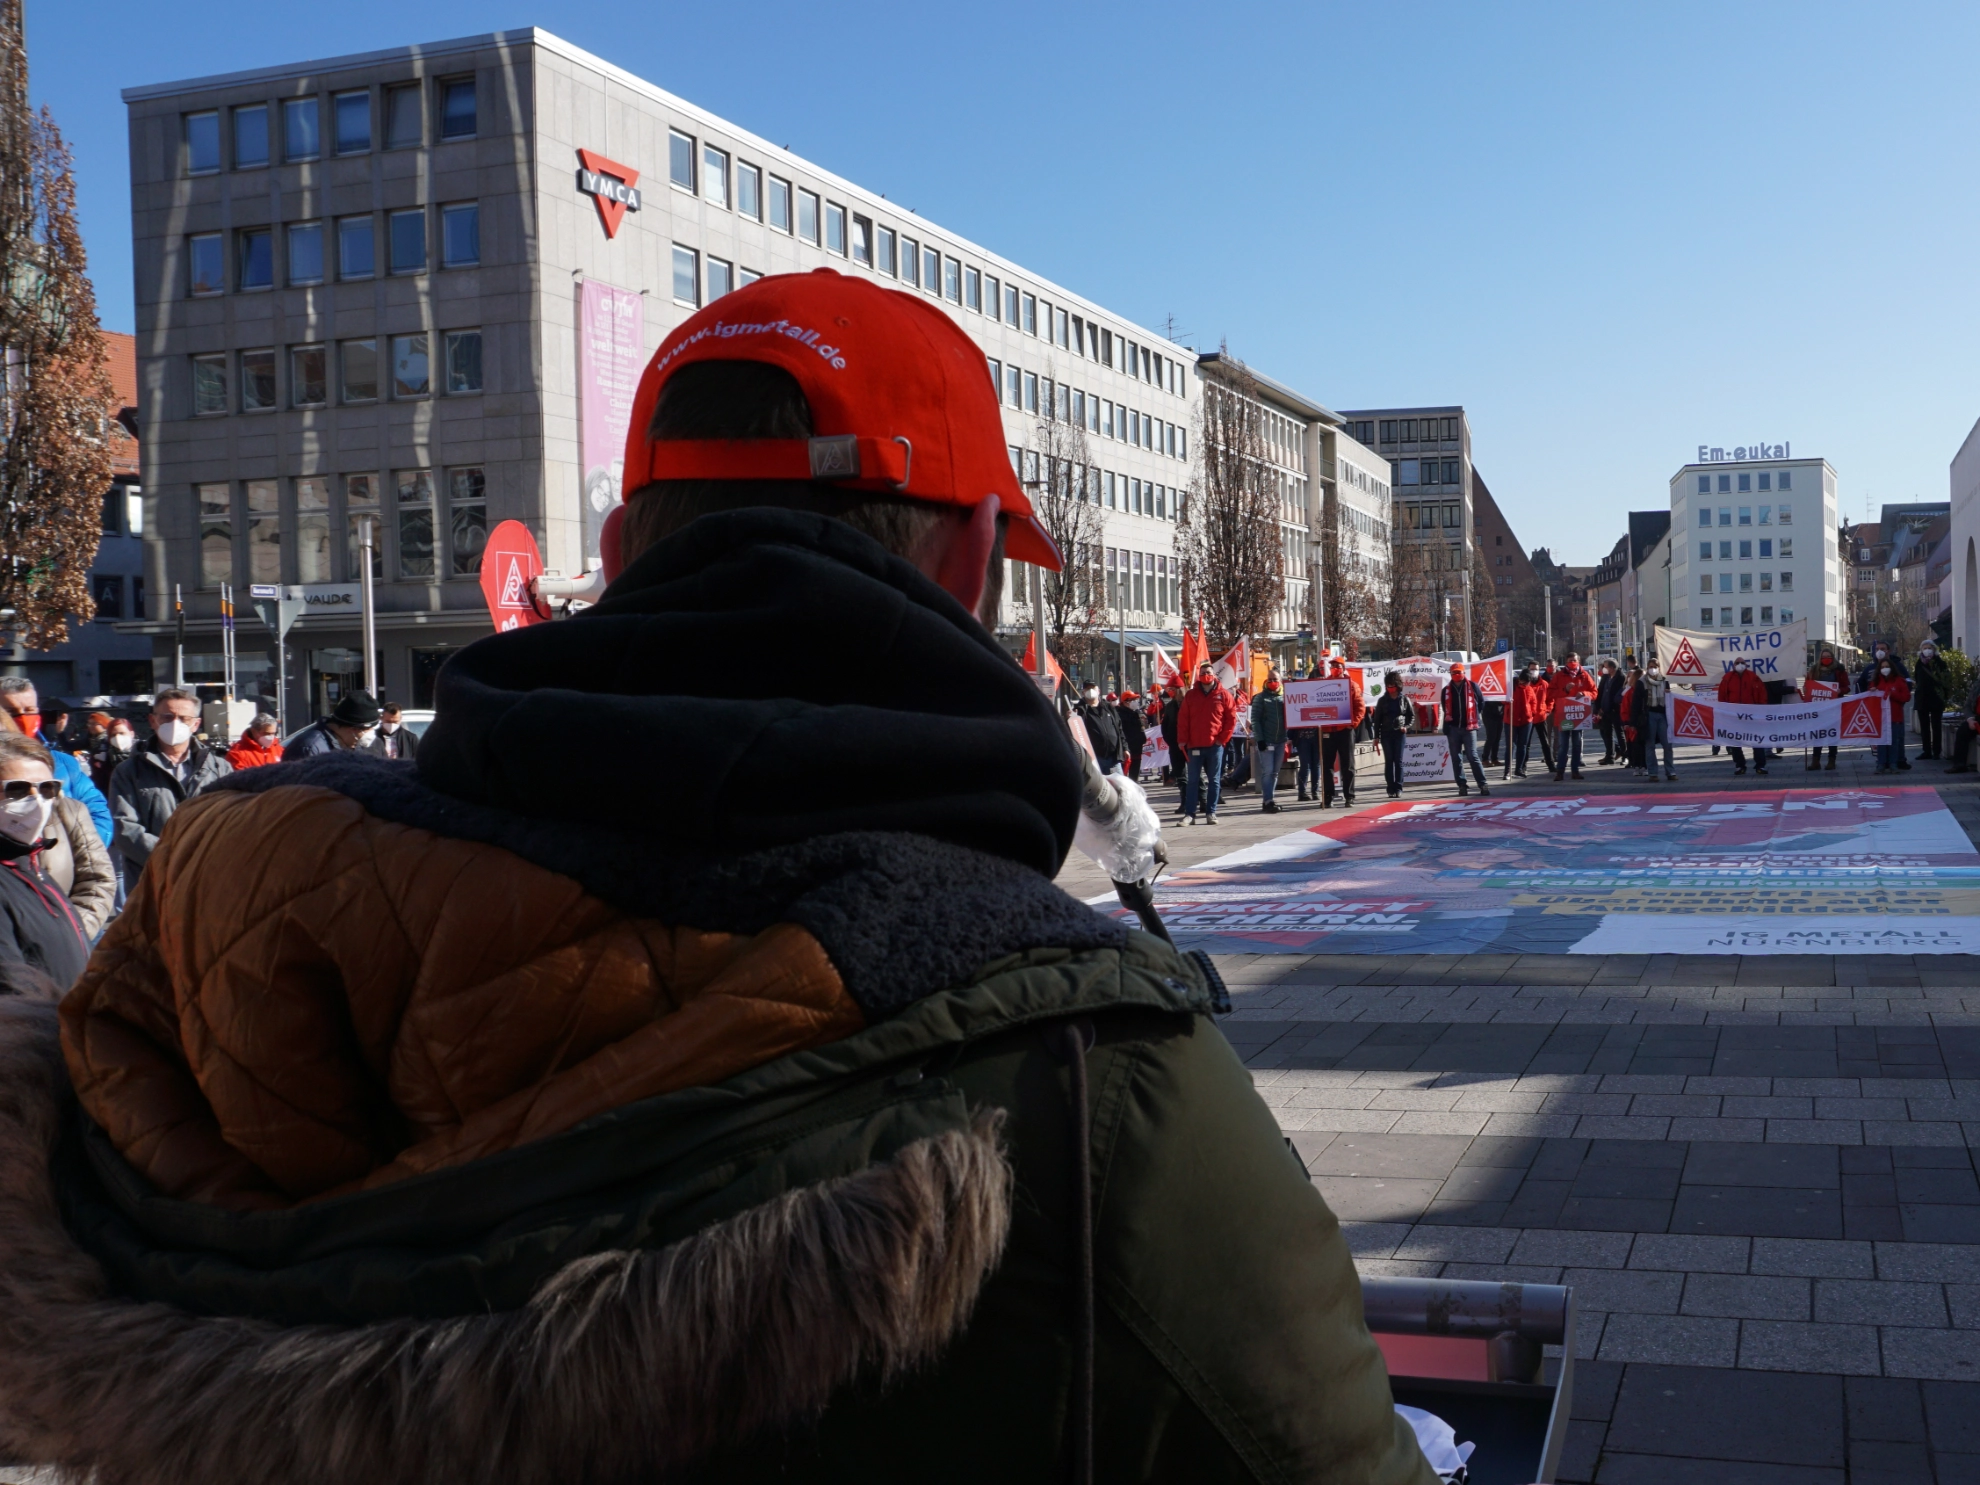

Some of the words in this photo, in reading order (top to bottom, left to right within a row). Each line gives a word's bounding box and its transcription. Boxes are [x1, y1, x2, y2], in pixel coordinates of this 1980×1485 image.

[588, 172, 638, 207] YMCA
[657, 320, 846, 371] www.igmetall.de
[304, 593, 353, 605] VAUDE
[1715, 631, 1782, 652] TRAFO
[1366, 667, 1381, 677] Der
[1286, 693, 1309, 704] WIR
[1811, 689, 1833, 697] MEHR
[1765, 711, 1819, 721] Siemens
[1717, 729, 1765, 743] Mobility
[1769, 732, 1806, 742] GmbH
[1810, 728, 1837, 739] NBG
[1409, 798, 1587, 812] WIR
[1576, 905, 1950, 914] Ausgebildeten
